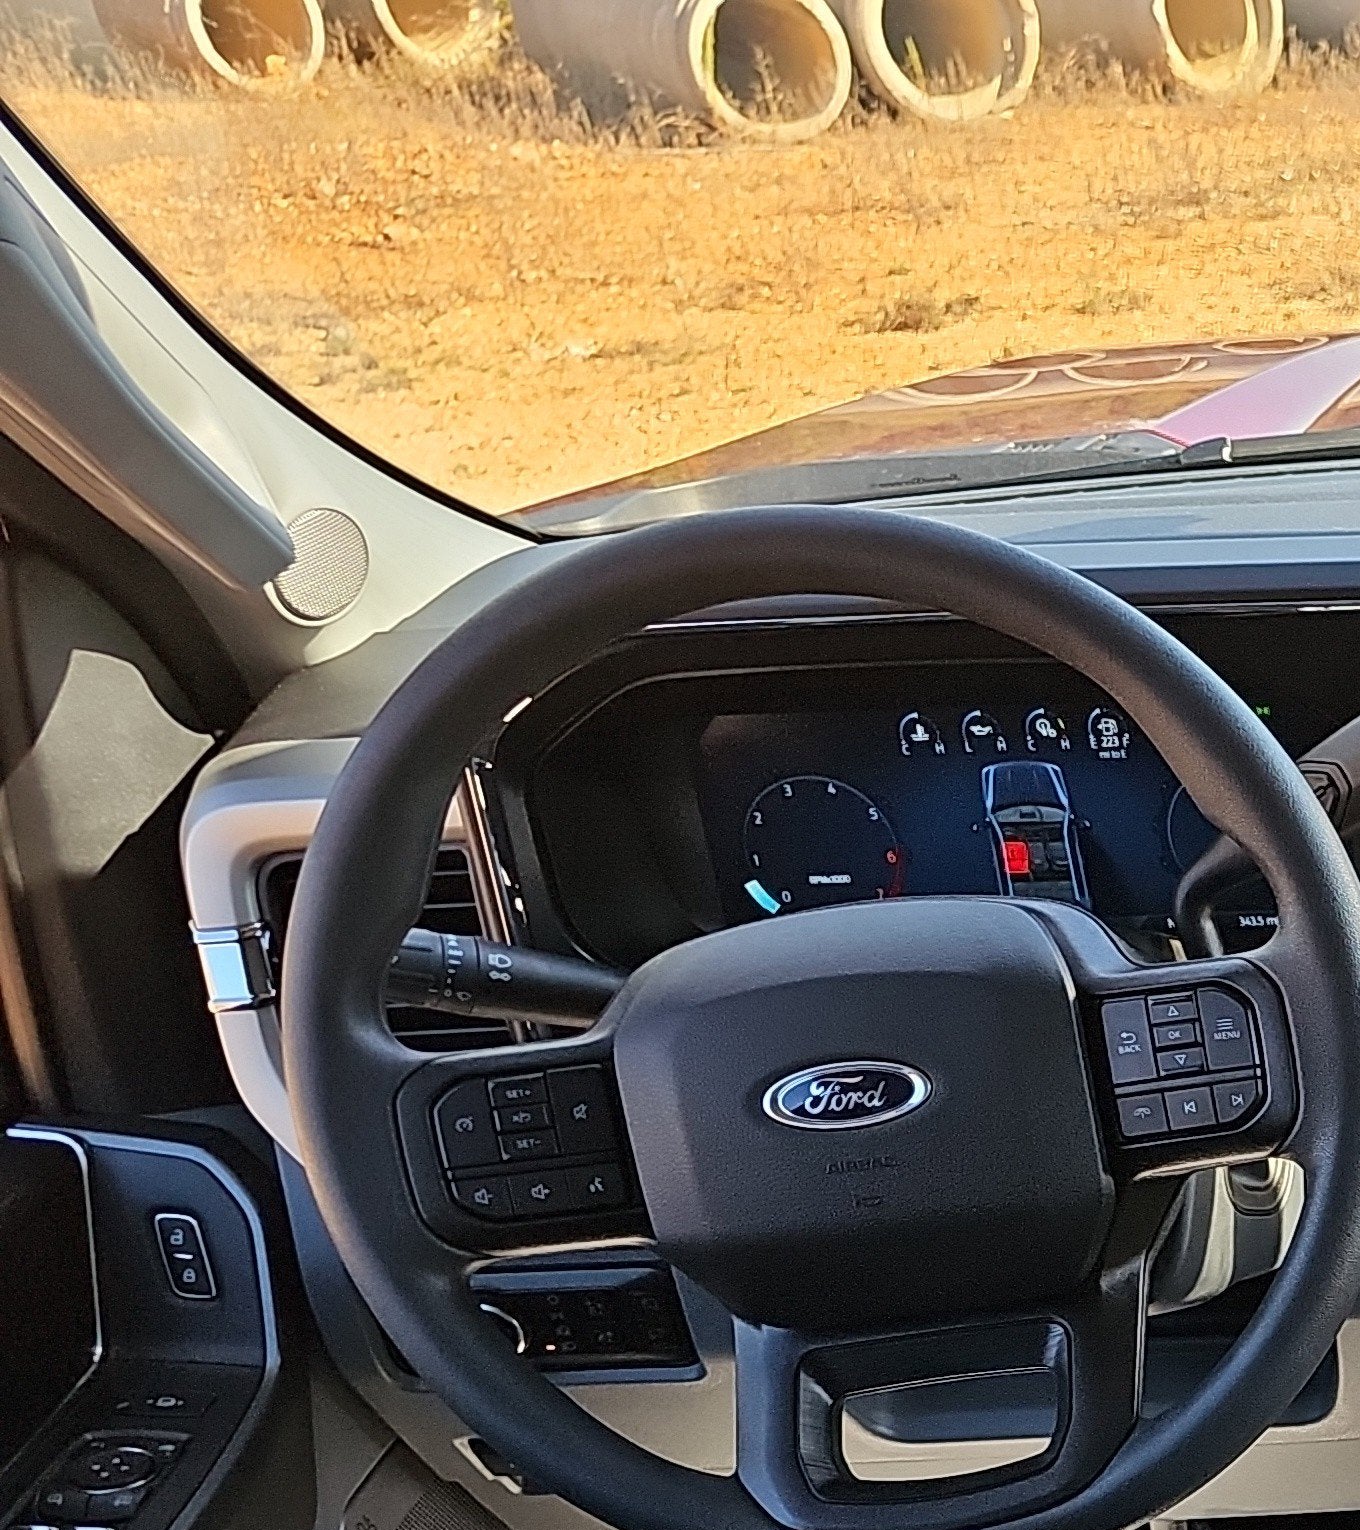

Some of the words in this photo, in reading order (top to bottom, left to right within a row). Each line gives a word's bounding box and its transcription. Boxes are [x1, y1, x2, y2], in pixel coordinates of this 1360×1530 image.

[783, 784, 792, 796] 3
[828, 782, 836, 794] 4
[753, 812, 763, 825] 2
[869, 808, 878, 820] 5
[753, 854, 759, 866] 1
[887, 850, 896, 863] 6
[782, 891, 791, 902] 0
[1168, 1030, 1182, 1039] OK
[1213, 1030, 1241, 1040] MENU
[1118, 1045, 1142, 1054] BACK
[804, 1076, 886, 1114] Ford
